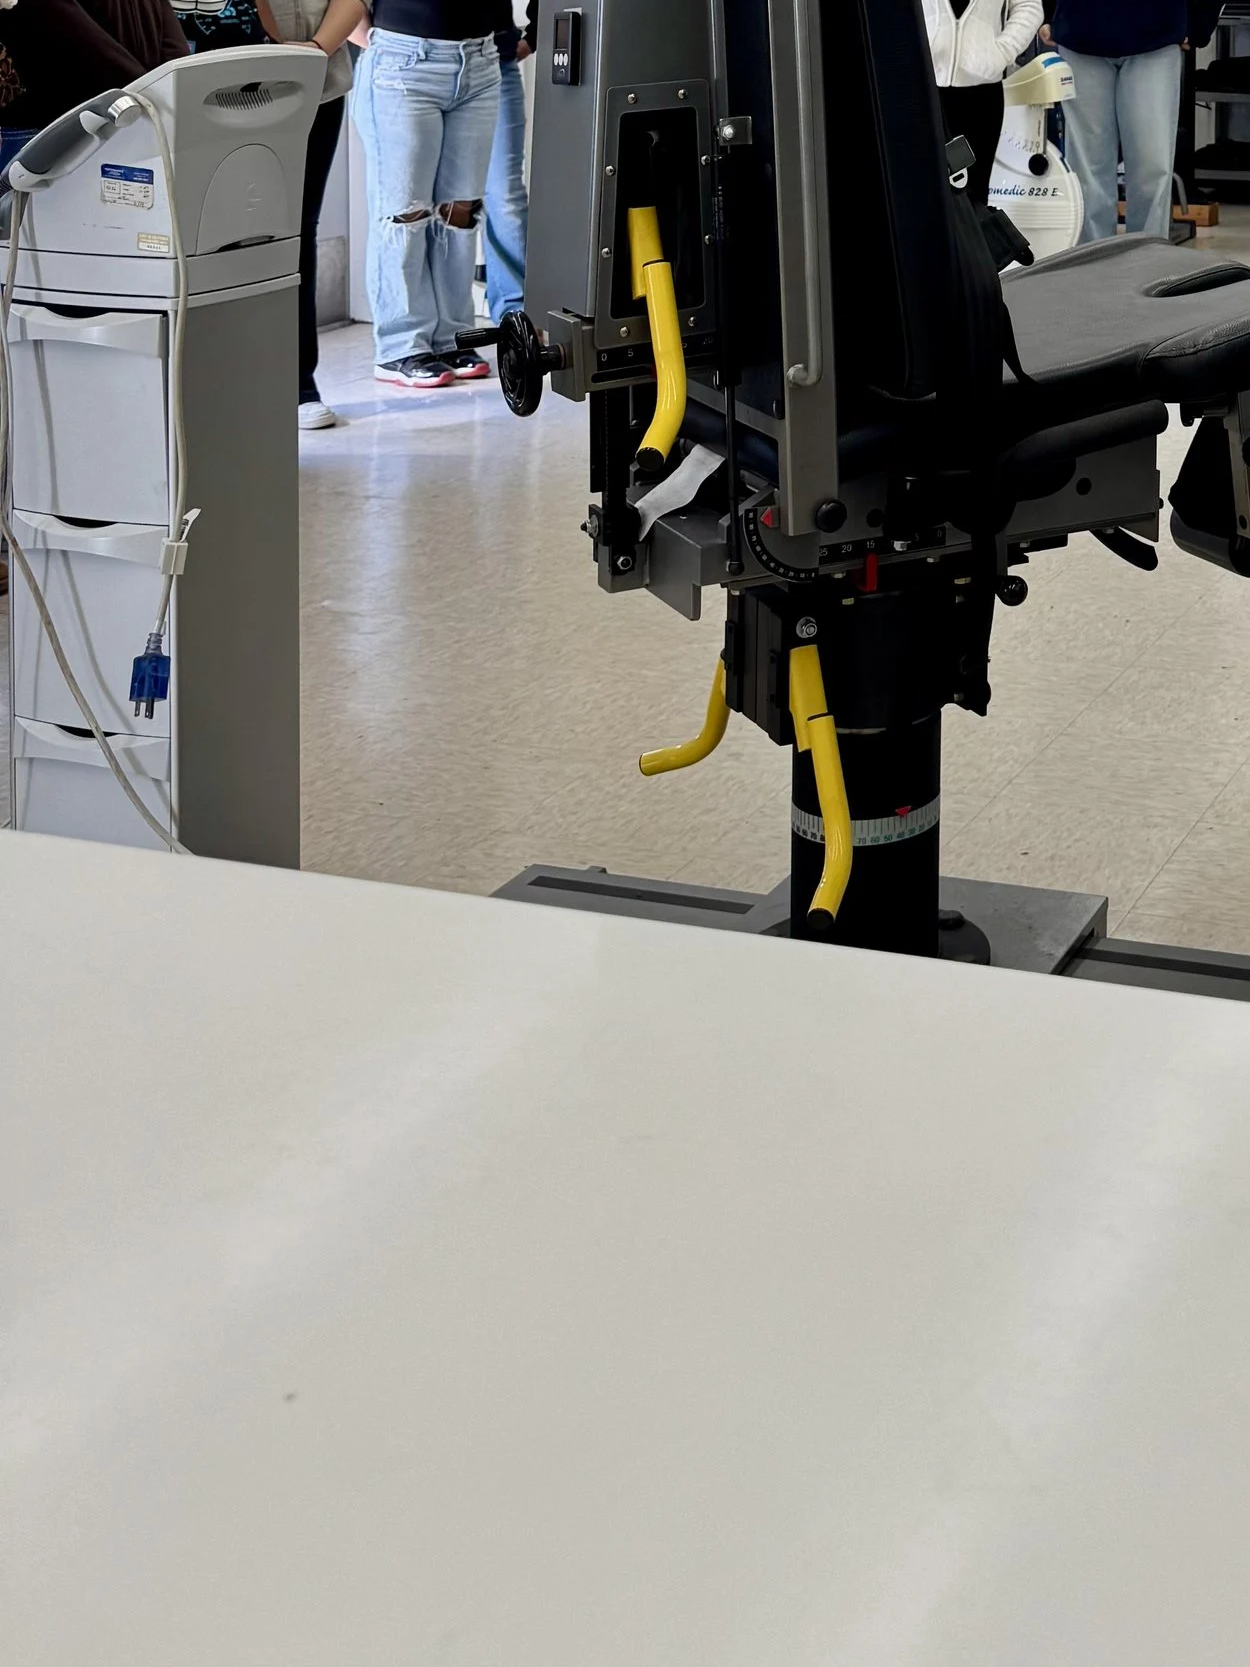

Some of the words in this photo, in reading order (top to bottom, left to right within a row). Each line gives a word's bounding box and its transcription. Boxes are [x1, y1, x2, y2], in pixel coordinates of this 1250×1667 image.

[1028, 187, 1049, 197] 828
[601, 352, 608, 362] 0
[627, 348, 634, 357] 5
[841, 543, 853, 553] 20
[866, 539, 875, 550] 15
[857, 837, 867, 845] 70
[870, 836, 881, 844] 60
[883, 834, 894, 842] 50
